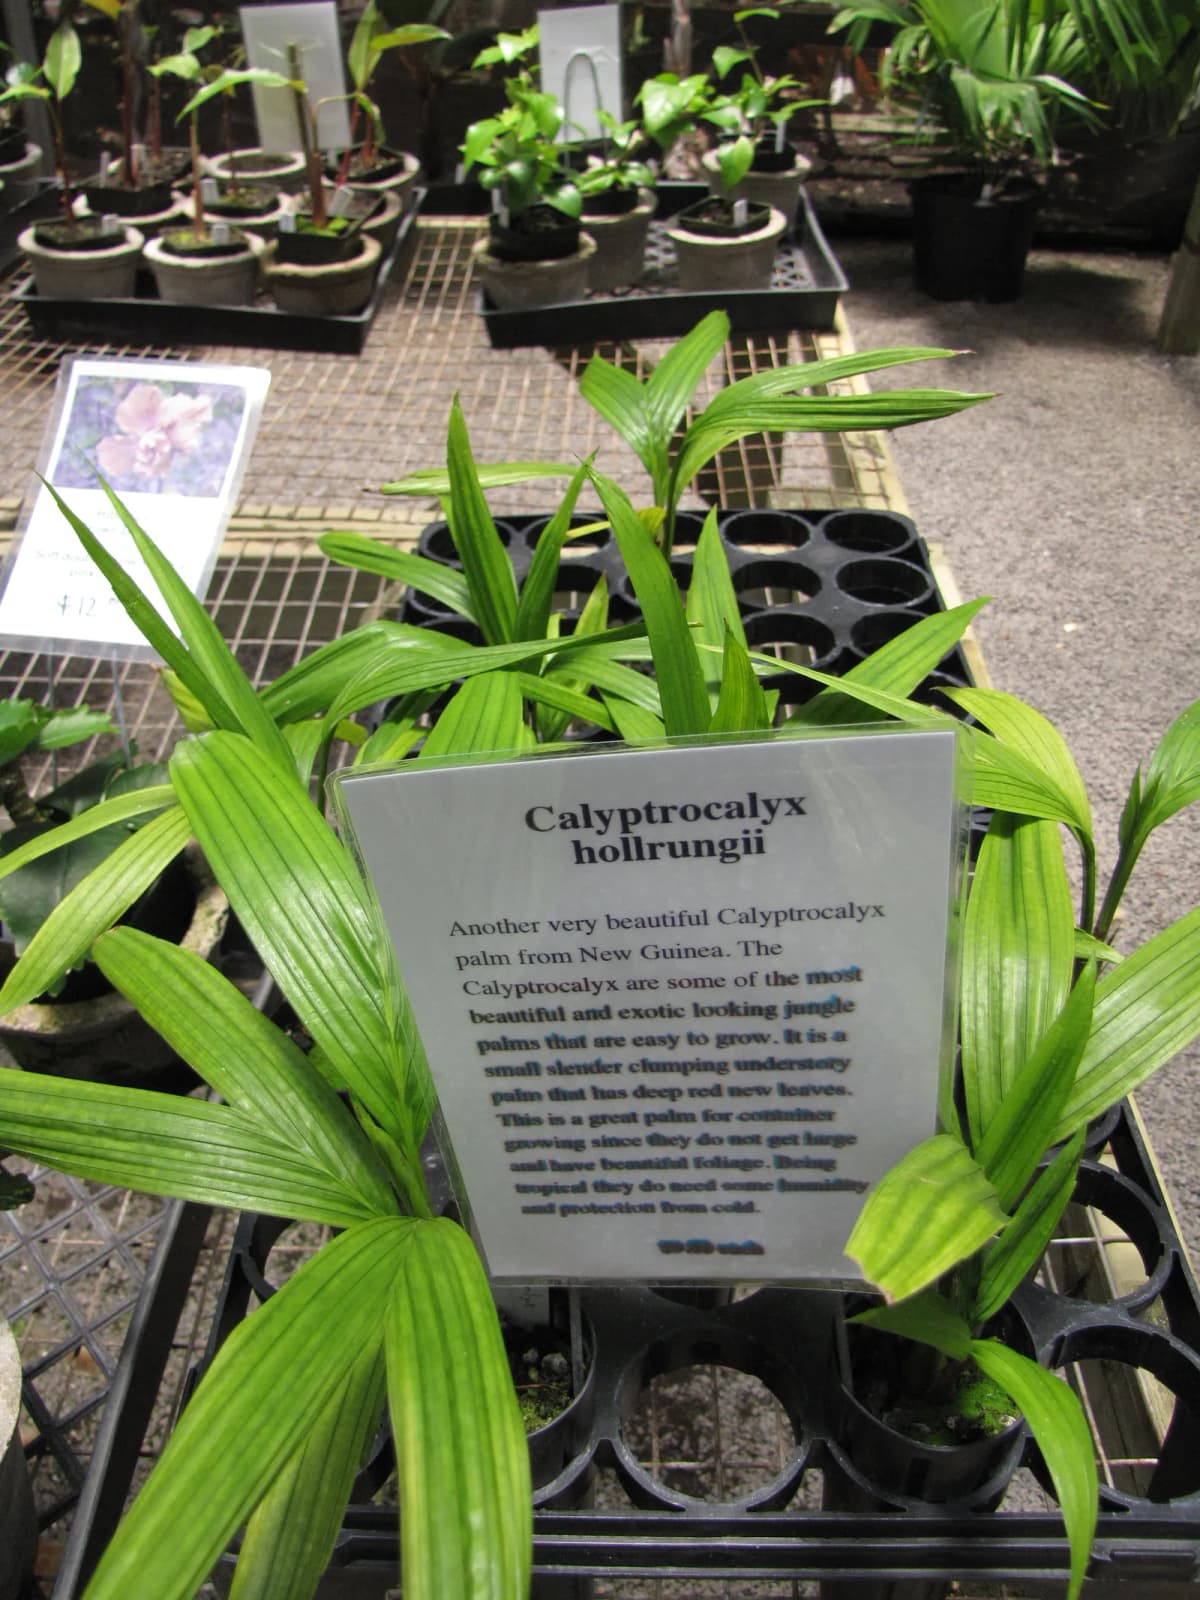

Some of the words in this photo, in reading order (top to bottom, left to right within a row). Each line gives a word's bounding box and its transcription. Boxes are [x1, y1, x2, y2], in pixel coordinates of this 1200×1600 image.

[525, 792, 807, 834] Calyptrocalyx
[571, 829, 765, 865] hollrungii
[449, 918, 540, 937] Another
[548, 917, 597, 935] very
[606, 909, 709, 931] beautiful
[717, 901, 885, 929] Calyptrocalyx
[455, 949, 511, 971] palm
[518, 948, 572, 966] from
[580, 946, 632, 964] New
[640, 942, 730, 961] Guinea.
[737, 939, 783, 957] The
[463, 977, 619, 999] Calyptrocalyx
[626, 979, 659, 991] are
[667, 976, 726, 989] some
[734, 971, 759, 987] of
[765, 971, 800, 987] the
[806, 966, 863, 985] most
[469, 1005, 566, 1024] beautiful
[573, 1004, 611, 1021] and
[618, 1002, 685, 1020] exotic
[692, 1001, 778, 1020] looking
[783, 995, 856, 1019] jungle
[476, 1036, 541, 1055] palms
[544, 1033, 587, 1050] that
[593, 1035, 627, 1049] are
[632, 1033, 680, 1050] easy
[686, 1031, 709, 1046] to
[715, 1033, 779, 1049] grow.
[783, 1028, 803, 1044] It
[807, 1028, 828, 1043] is
[832, 1030, 848, 1043] a
[484, 1061, 542, 1077] small
[546, 1057, 624, 1075] slender
[628, 1057, 730, 1076] clumping
[733, 1056, 851, 1073] understory
[490, 1088, 543, 1106] palm
[547, 1086, 586, 1101] that
[591, 1085, 628, 1100] has
[632, 1084, 683, 1101] deep
[688, 1083, 724, 1098] red
[727, 1085, 773, 1098] new
[777, 1081, 853, 1097] leaves.
[496, 1112, 543, 1127] This
[547, 1113, 566, 1126] is
[571, 1115, 583, 1126] a
[588, 1111, 639, 1128] great
[643, 1108, 697, 1127] palm
[702, 1109, 734, 1124] for
[504, 1136, 586, 1152] growing
[591, 1135, 642, 1148] since
[645, 1131, 691, 1149] they
[695, 1132, 724, 1146] do
[727, 1133, 763, 1146] not
[766, 1133, 800, 1149] get
[510, 1159, 547, 1172] and
[549, 1159, 596, 1172] have
[639, 1178, 666, 1193] do
